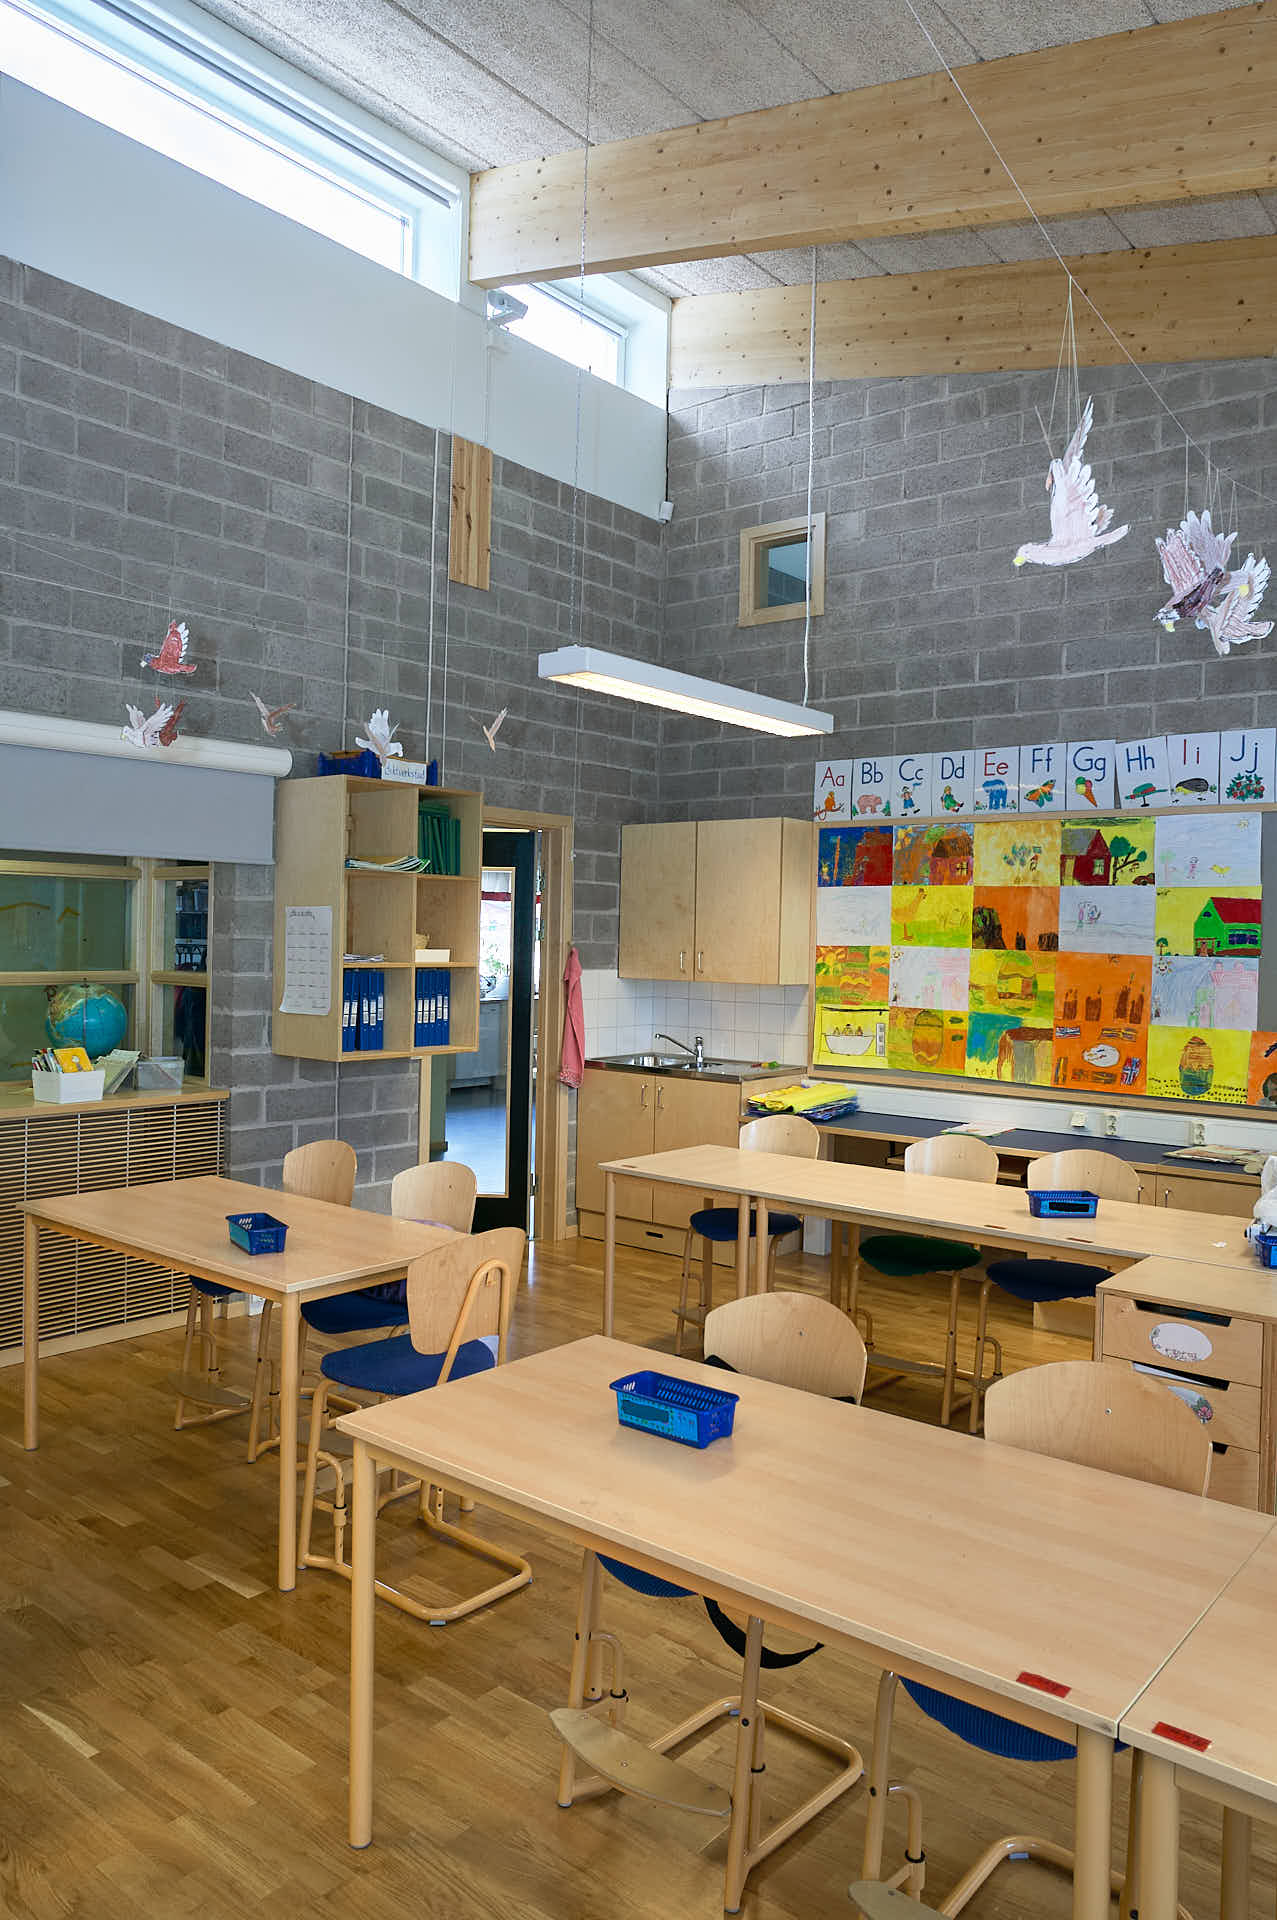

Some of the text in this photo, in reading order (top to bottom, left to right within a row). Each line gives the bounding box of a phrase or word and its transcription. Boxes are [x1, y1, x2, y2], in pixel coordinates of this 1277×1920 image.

[820, 735, 1259, 787] Aa Bb Cc Dd Ee Ff Gg Hh Ii Jj
